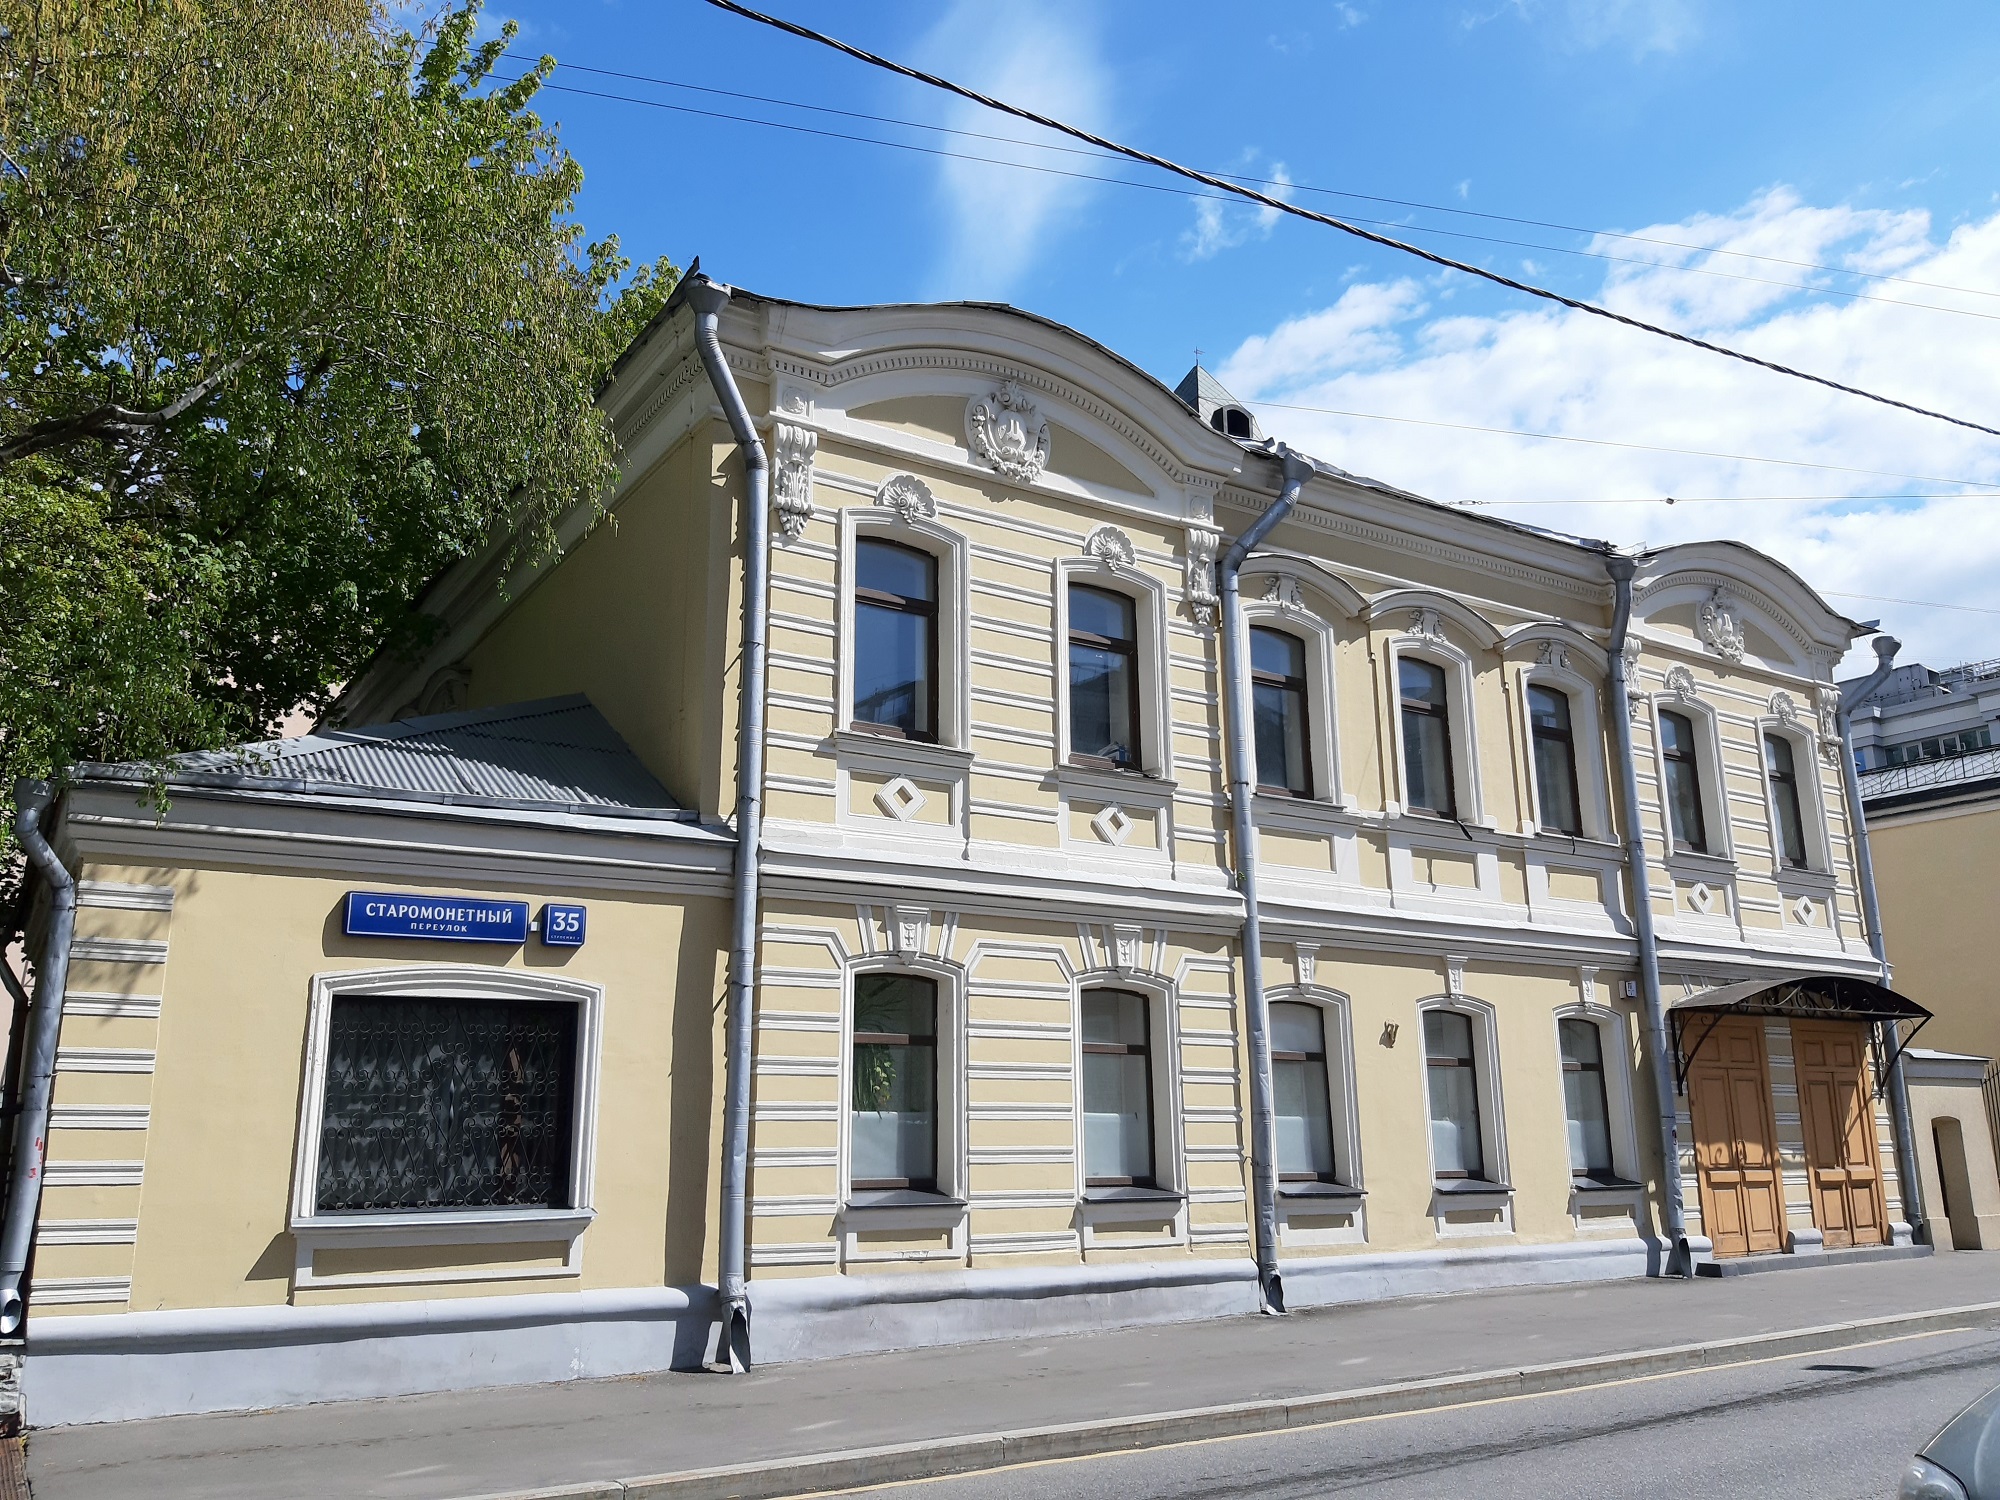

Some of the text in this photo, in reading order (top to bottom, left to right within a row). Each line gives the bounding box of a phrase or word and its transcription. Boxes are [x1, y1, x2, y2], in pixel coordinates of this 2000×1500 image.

[365, 902, 513, 924] СТАРОМОНЕТНЫЙ
[552, 912, 580, 932] 35
[410, 922, 468, 933] ПЕРЕУЛОК
